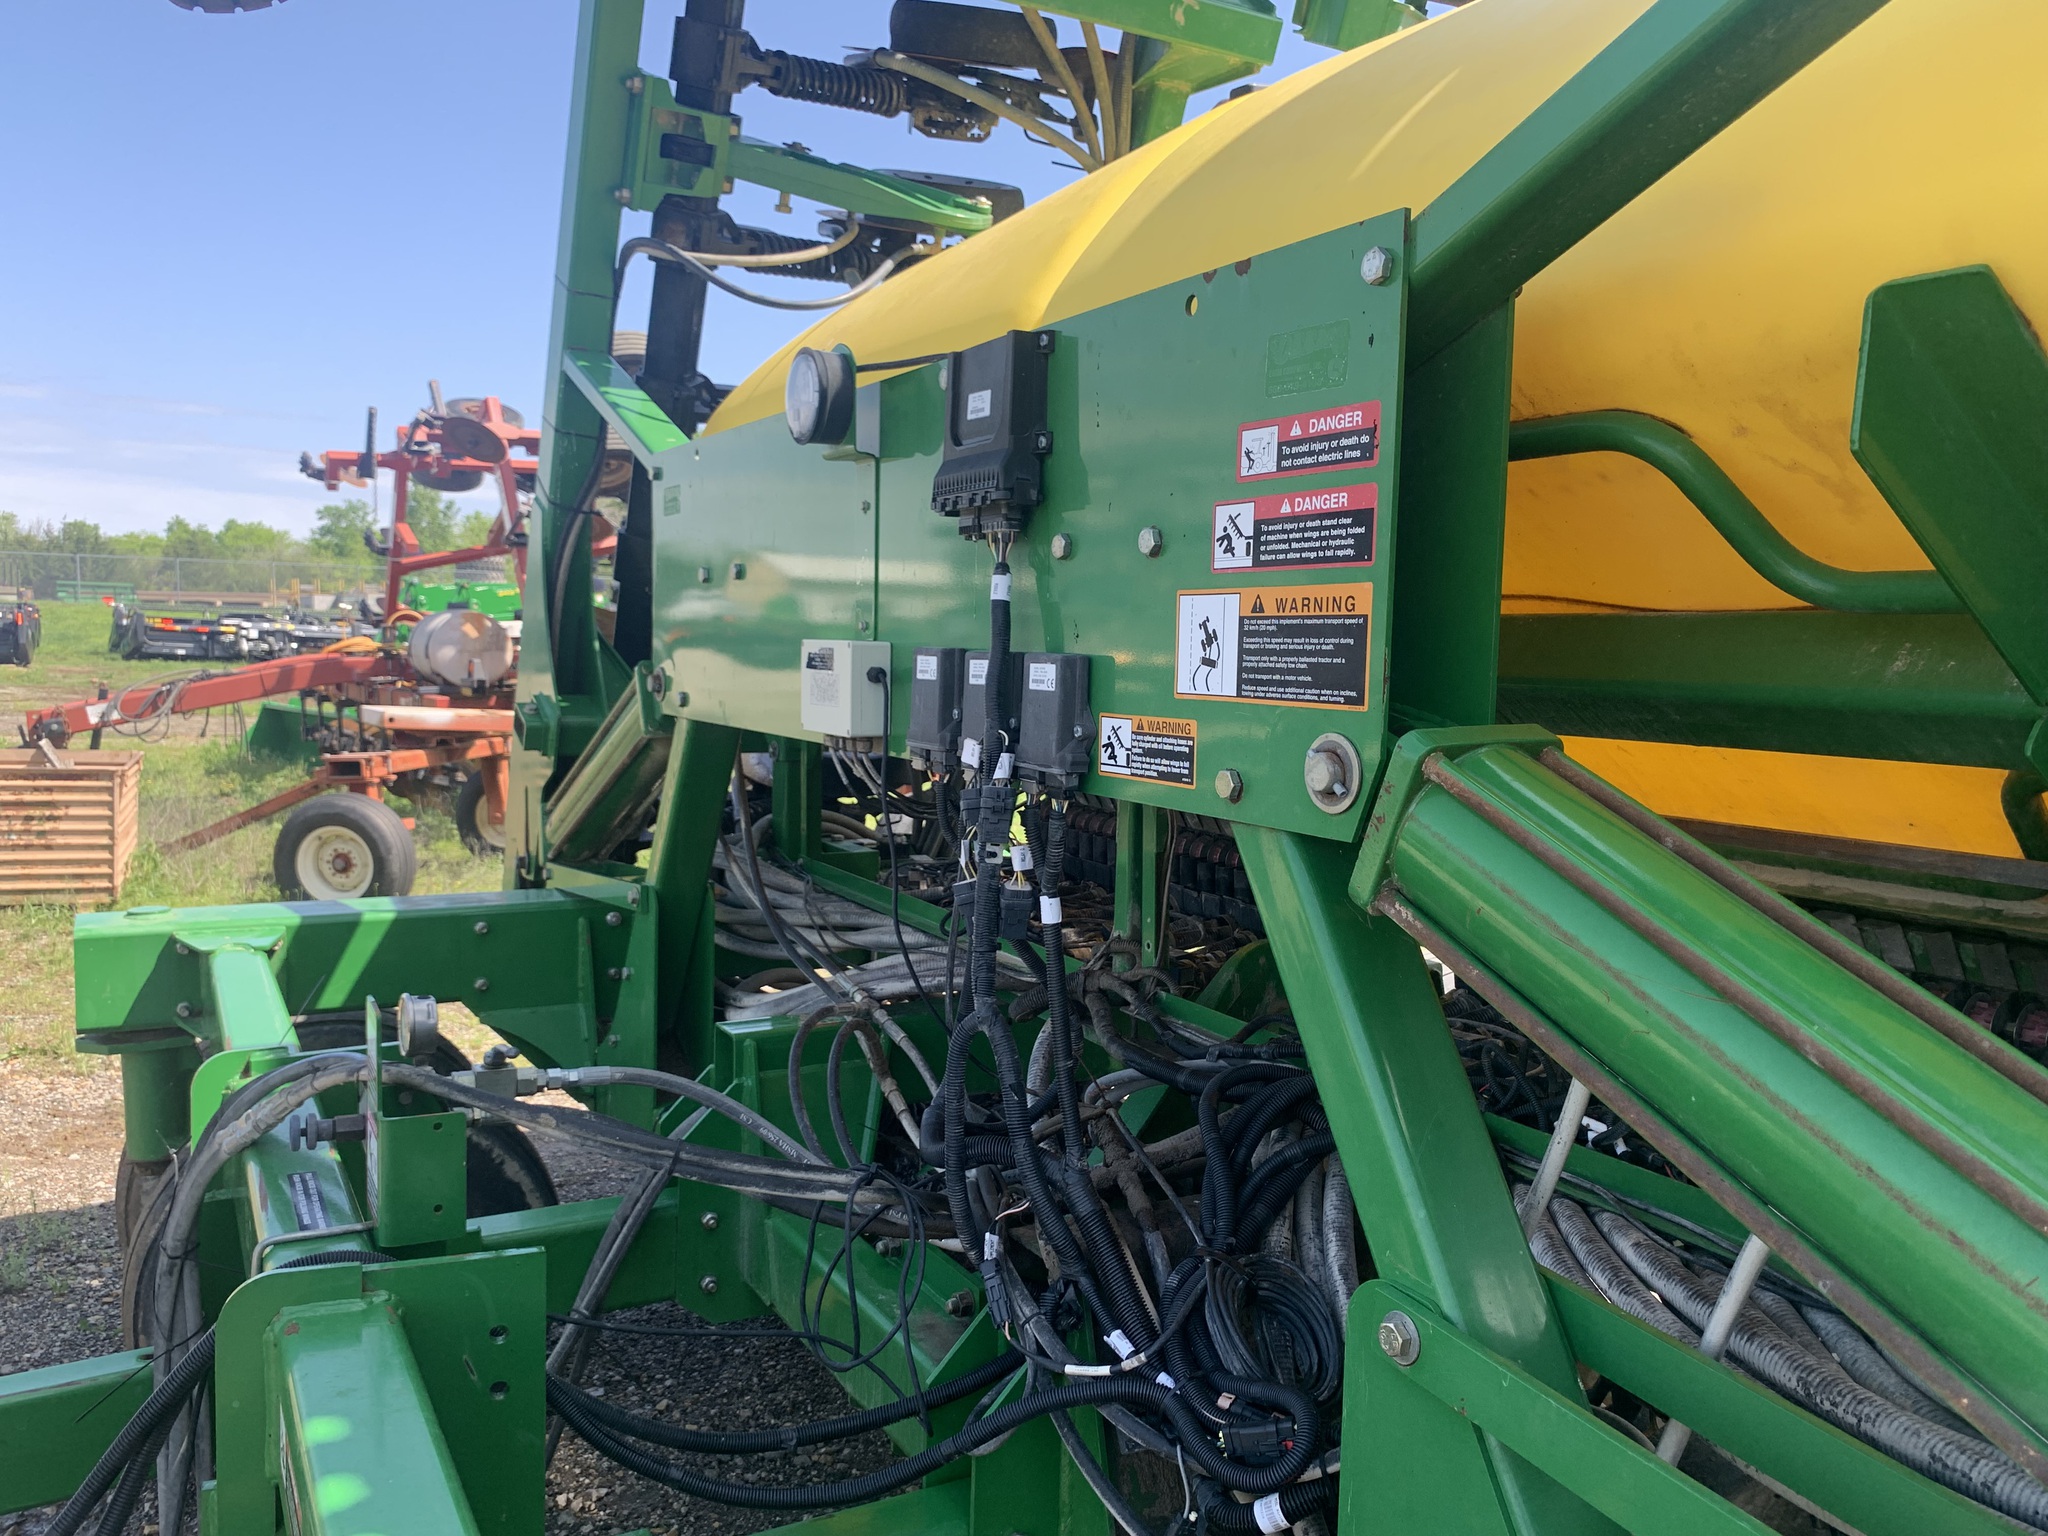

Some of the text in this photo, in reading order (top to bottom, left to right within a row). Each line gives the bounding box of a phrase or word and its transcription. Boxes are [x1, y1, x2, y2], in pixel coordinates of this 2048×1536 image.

[1309, 411, 1362, 433] DANGER
[1282, 446, 1290, 455] To
[1292, 443, 1309, 454] avoid
[1310, 441, 1330, 451] injury
[1340, 436, 1358, 446] death
[1360, 434, 1369, 443] do
[1281, 449, 1360, 467] not contact electric lines
[1294, 492, 1348, 512] DANGER
[1283, 522, 1298, 530] injury
[1322, 518, 1337, 526] stand
[1267, 533, 1288, 541] machine
[1331, 528, 1346, 536] being
[1347, 526, 1365, 534] folded
[1291, 540, 1320, 548] Mechanical
[1329, 538, 1354, 547] hydraulic
[1302, 551, 1317, 559] wings
[1335, 548, 1355, 557] rapidly.
[1276, 595, 1355, 613] WARNING
[1046, 678, 1054, 688] CE
[1147, 720, 1191, 735] WARNING
